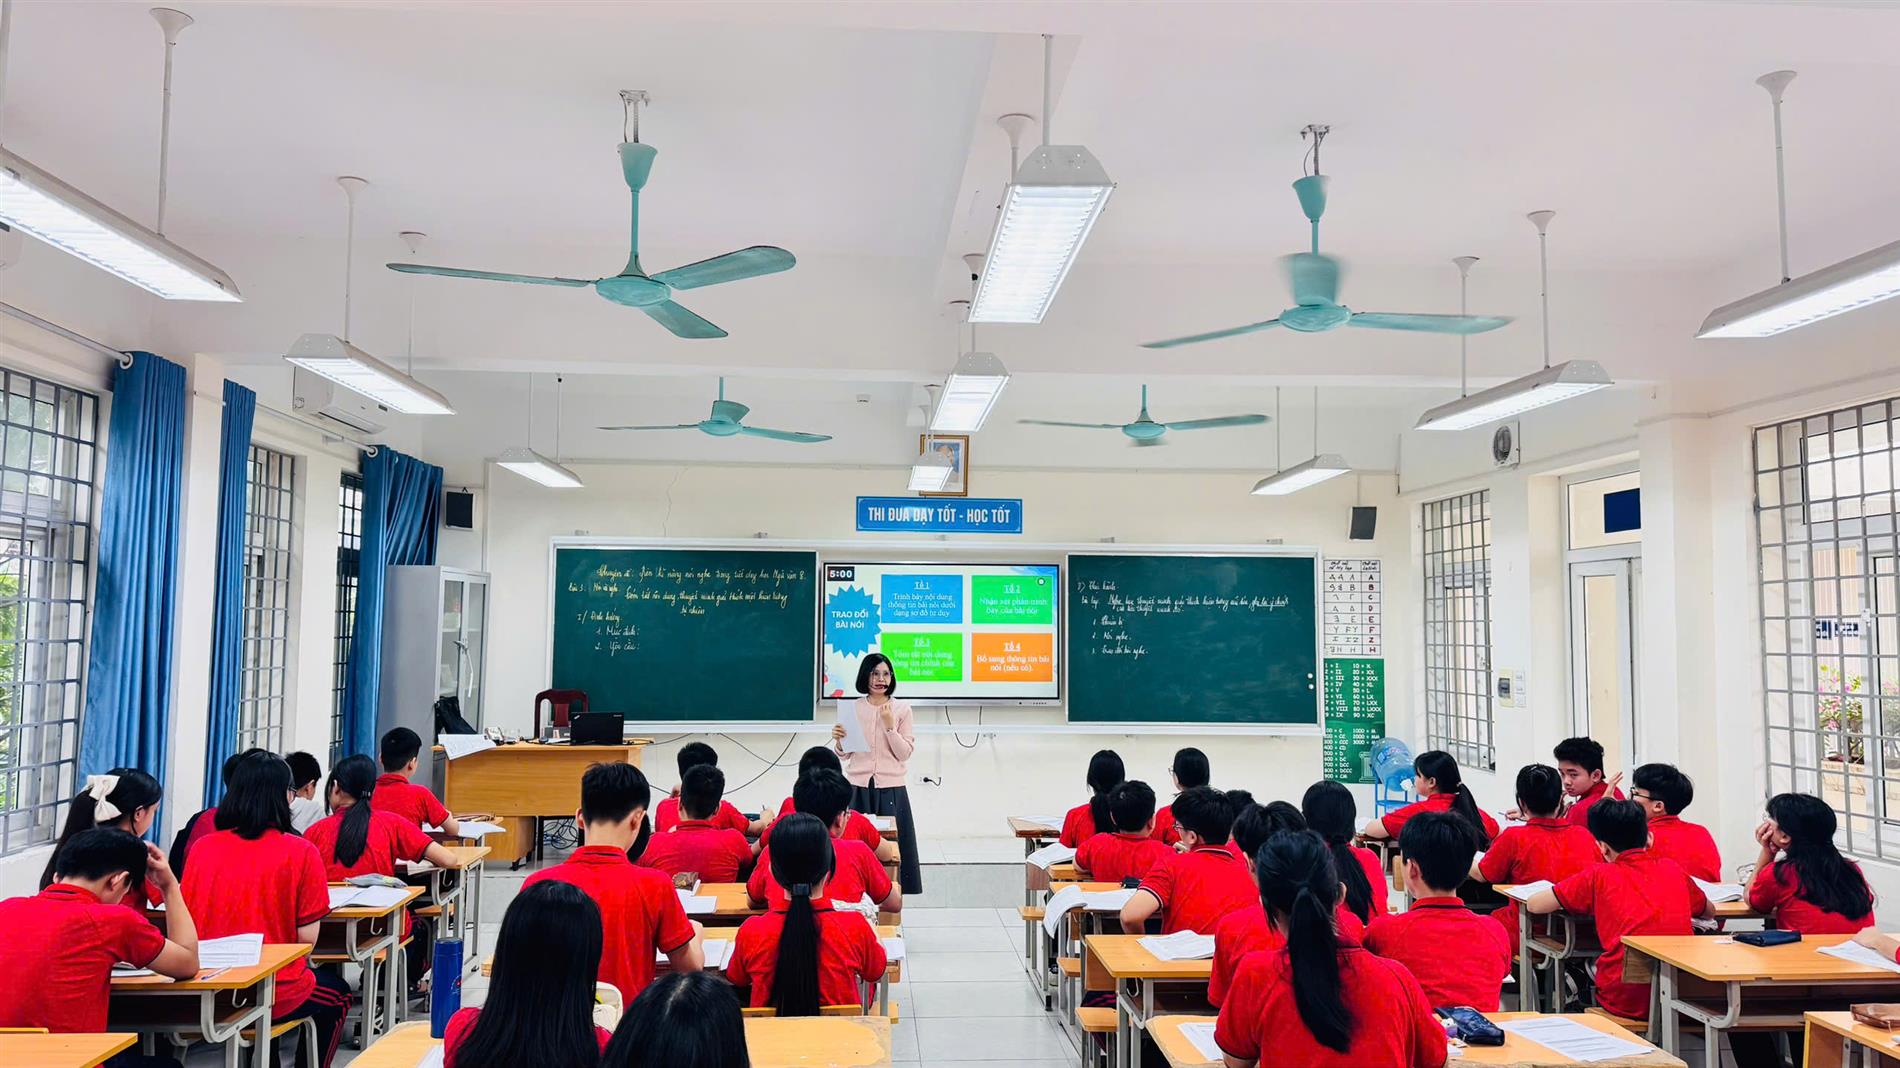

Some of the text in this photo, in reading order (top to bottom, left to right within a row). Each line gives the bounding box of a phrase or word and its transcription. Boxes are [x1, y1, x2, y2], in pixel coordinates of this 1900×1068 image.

[868, 507, 885, 521] THI
[888, 507, 909, 522] ĐUA
[913, 507, 934, 525] DẠY
[937, 503, 956, 523] TỐT
[967, 509, 988, 526] HỌC
[991, 504, 1011, 524] TỐT
[829, 570, 853, 579] 5:00
[914, 580, 924, 589] Tổ
[911, 593, 924, 602] bày
[925, 593, 936, 601] nội
[936, 593, 953, 602] dung
[888, 601, 906, 609] thông
[919, 608, 928, 616] đồ
[835, 620, 864, 629] BÀI NÓI
[1004, 641, 1015, 651] Tổ
[1007, 654, 1026, 664] thông
